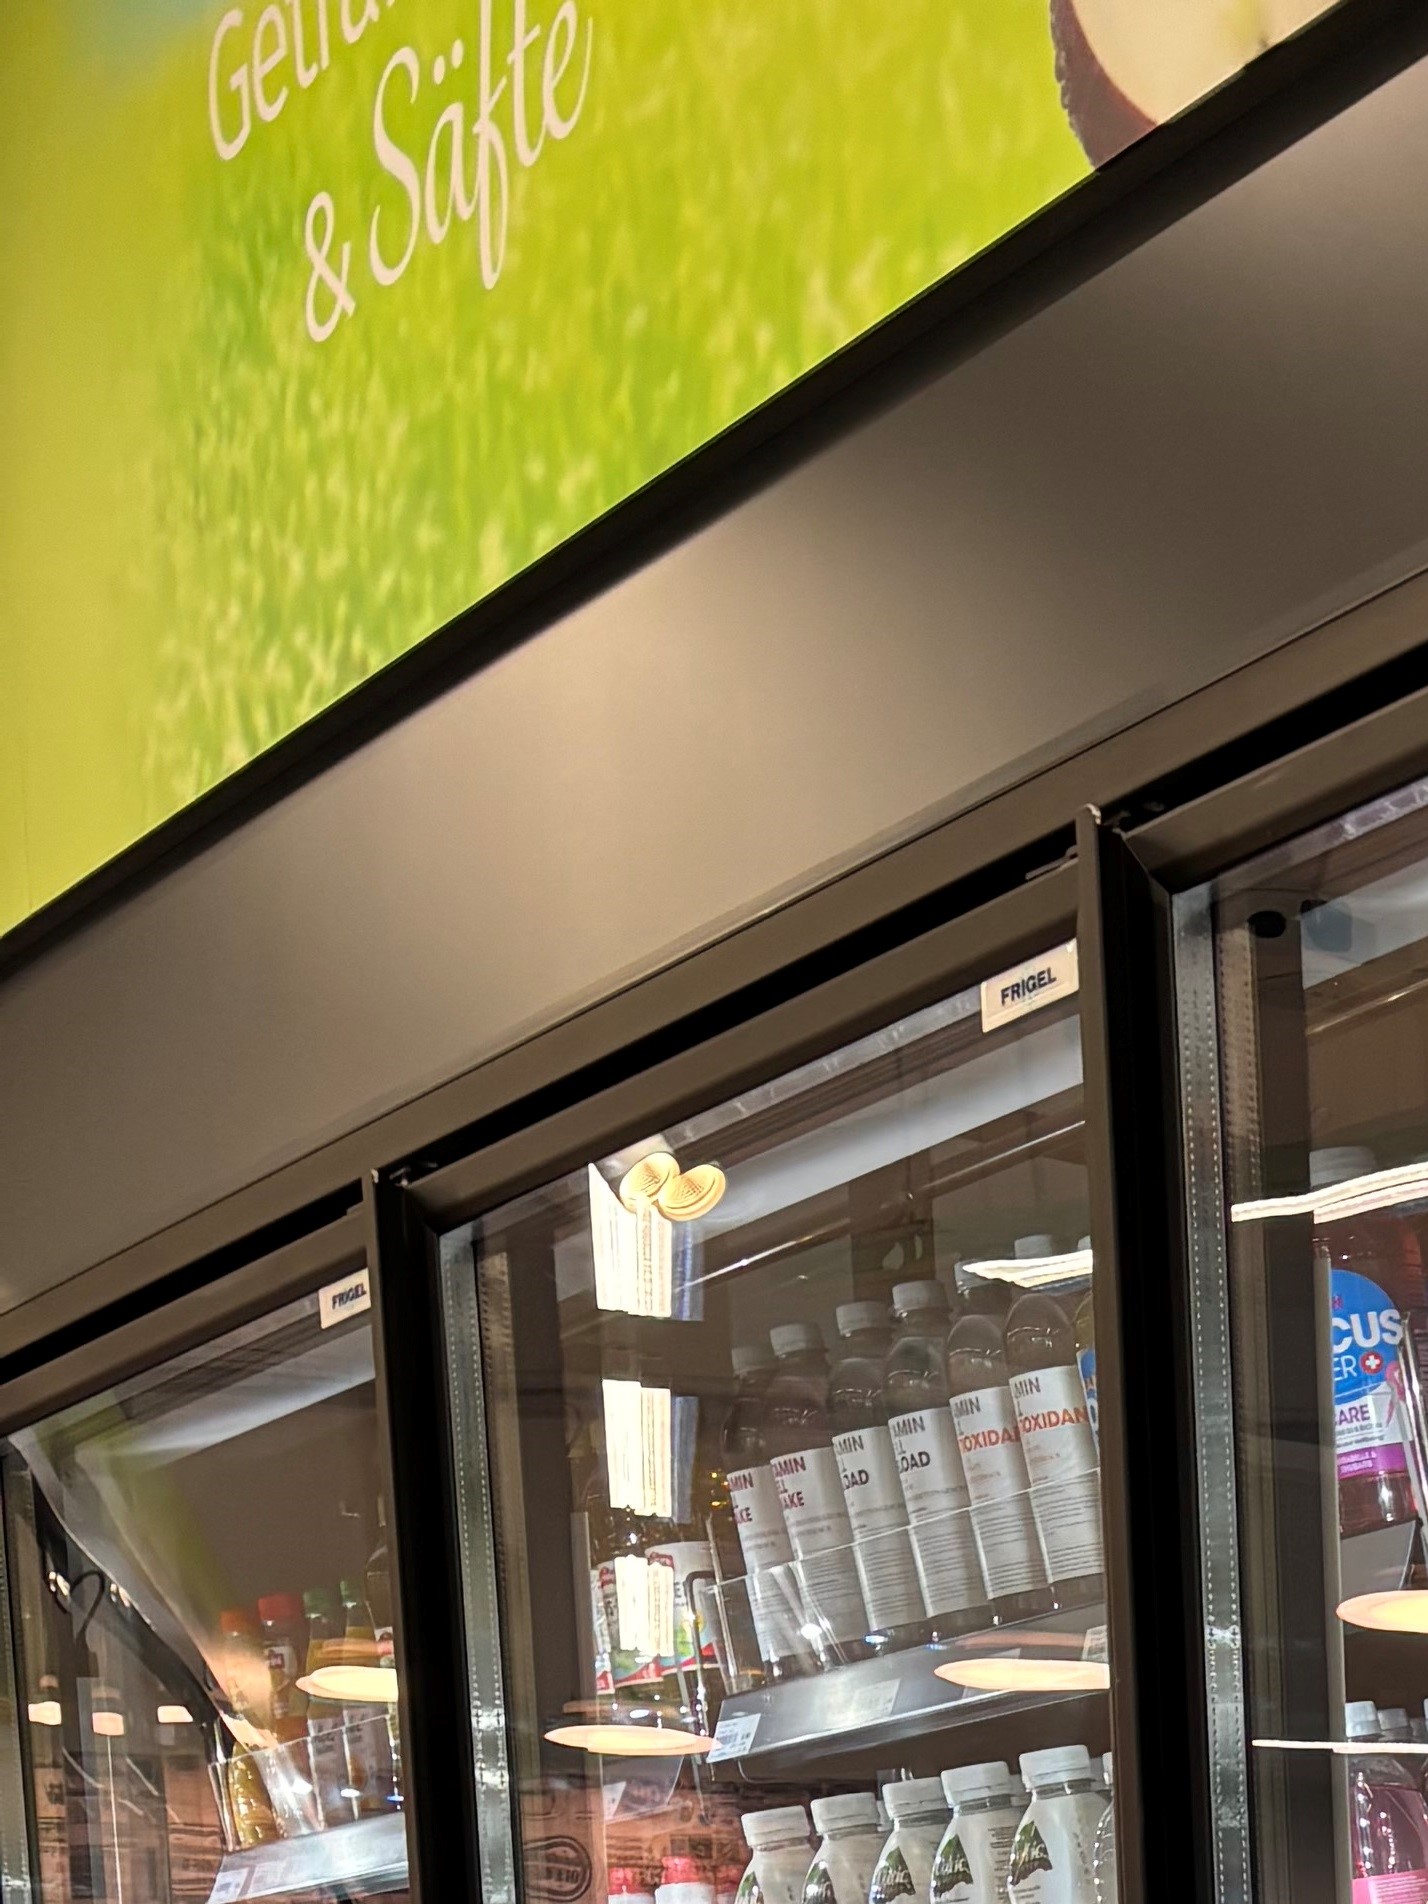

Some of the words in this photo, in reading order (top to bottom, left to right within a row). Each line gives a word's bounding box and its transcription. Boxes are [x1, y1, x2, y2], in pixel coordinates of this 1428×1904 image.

[305, 191, 355, 342] &
[369, 0, 593, 290] Säfte
[1000, 966, 1057, 1006] FRIGEL
[332, 1282, 367, 1311] FRIGEL
